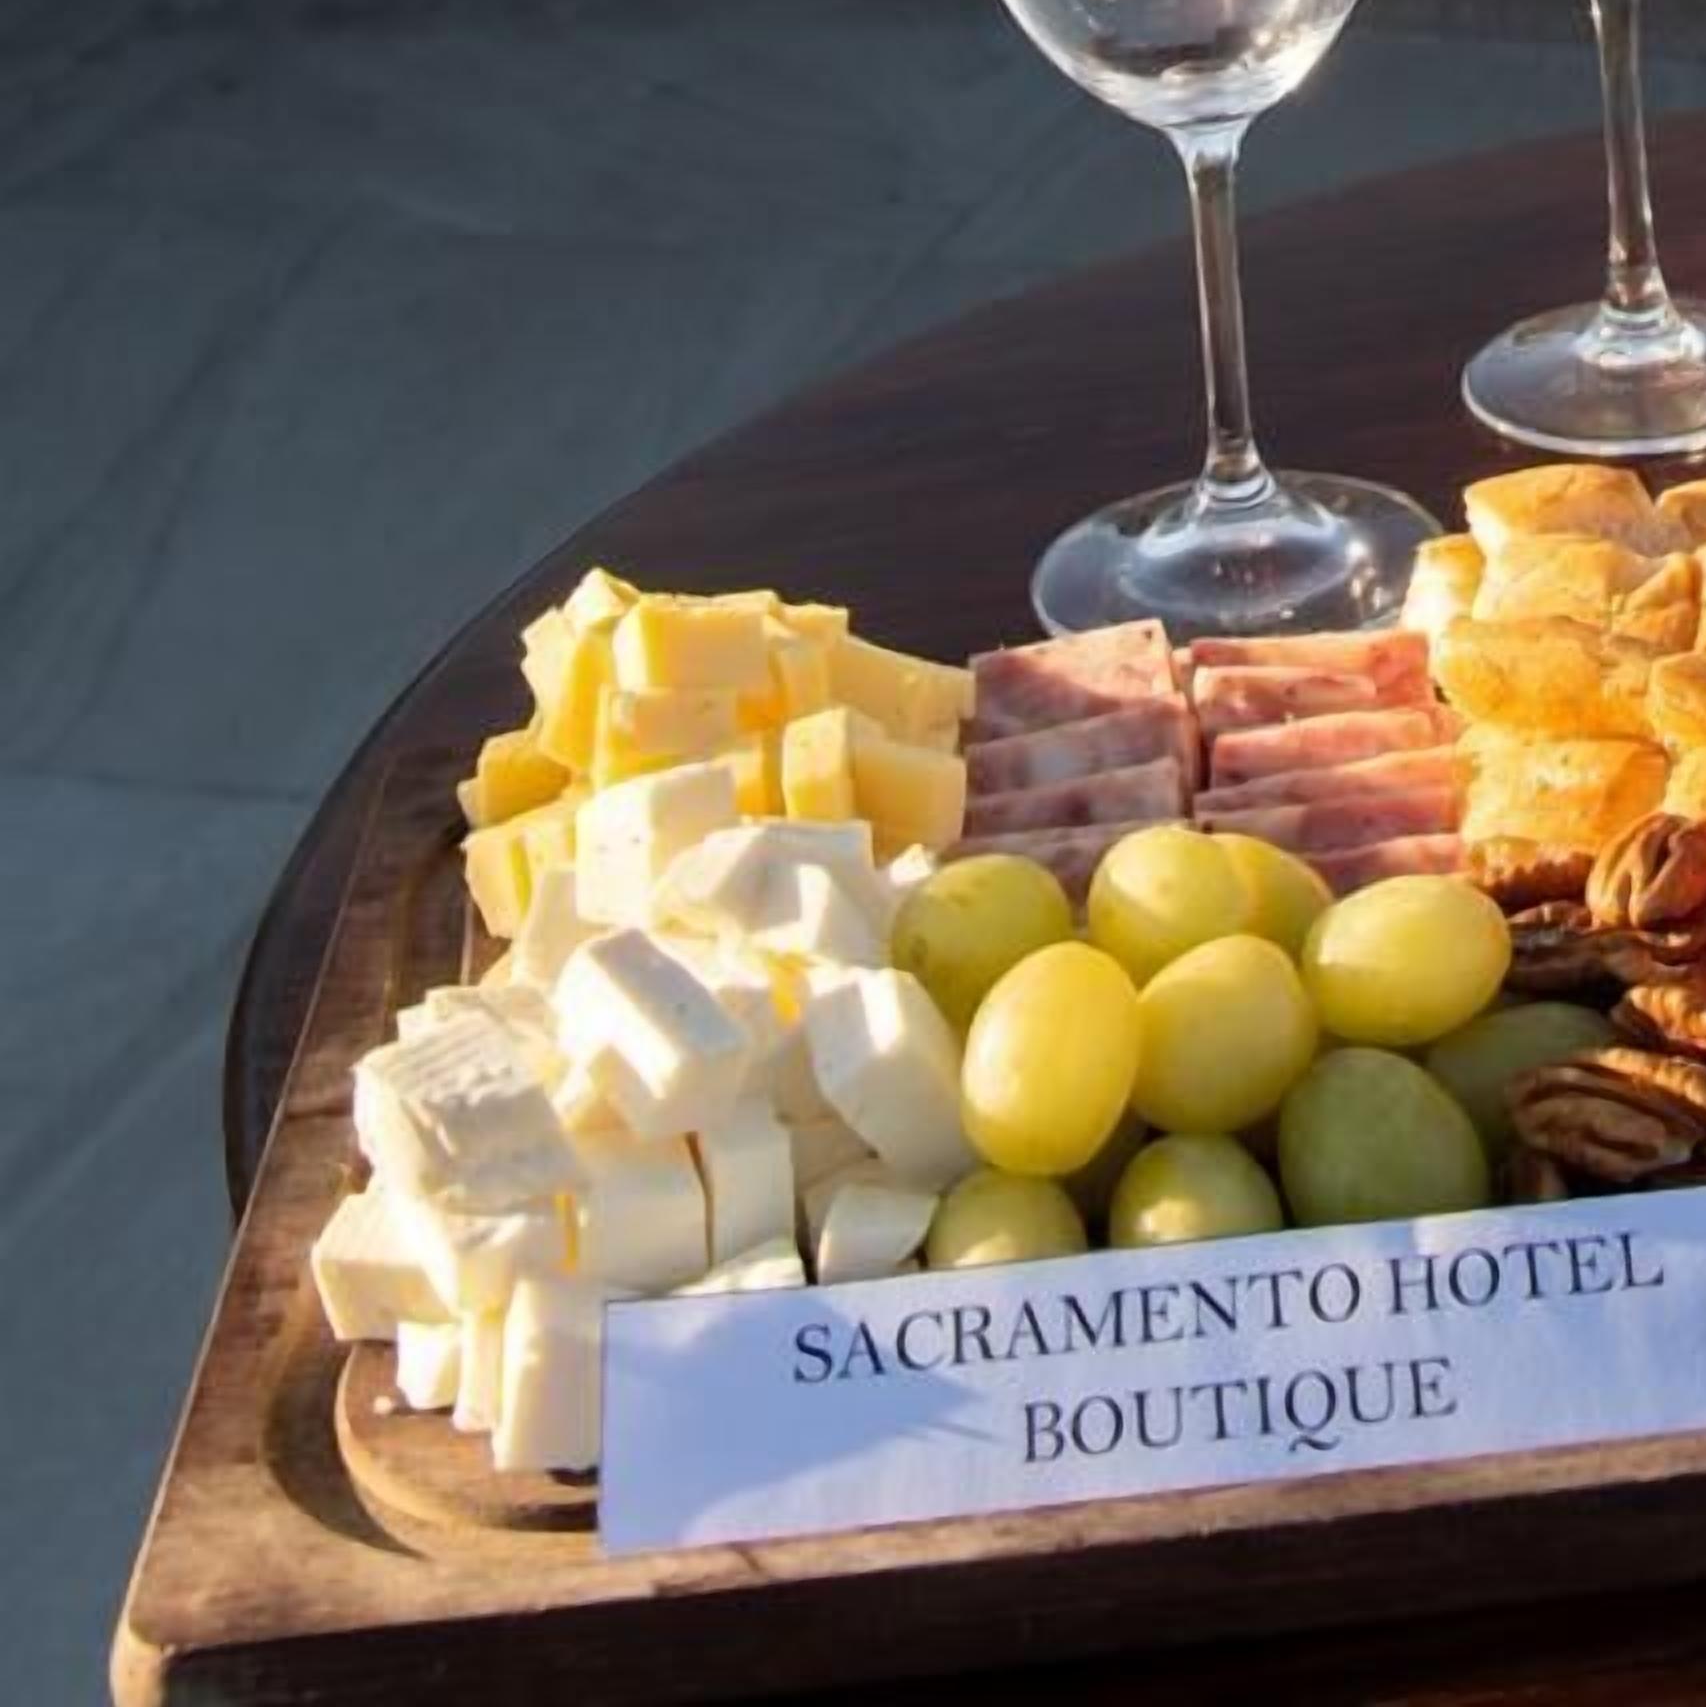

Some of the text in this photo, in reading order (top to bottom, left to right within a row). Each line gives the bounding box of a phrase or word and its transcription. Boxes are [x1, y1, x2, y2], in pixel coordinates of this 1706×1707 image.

[792, 1232, 1667, 1384] SACRAMENTO HOTEL
[1021, 1358, 1459, 1466] BOUTIQUE
